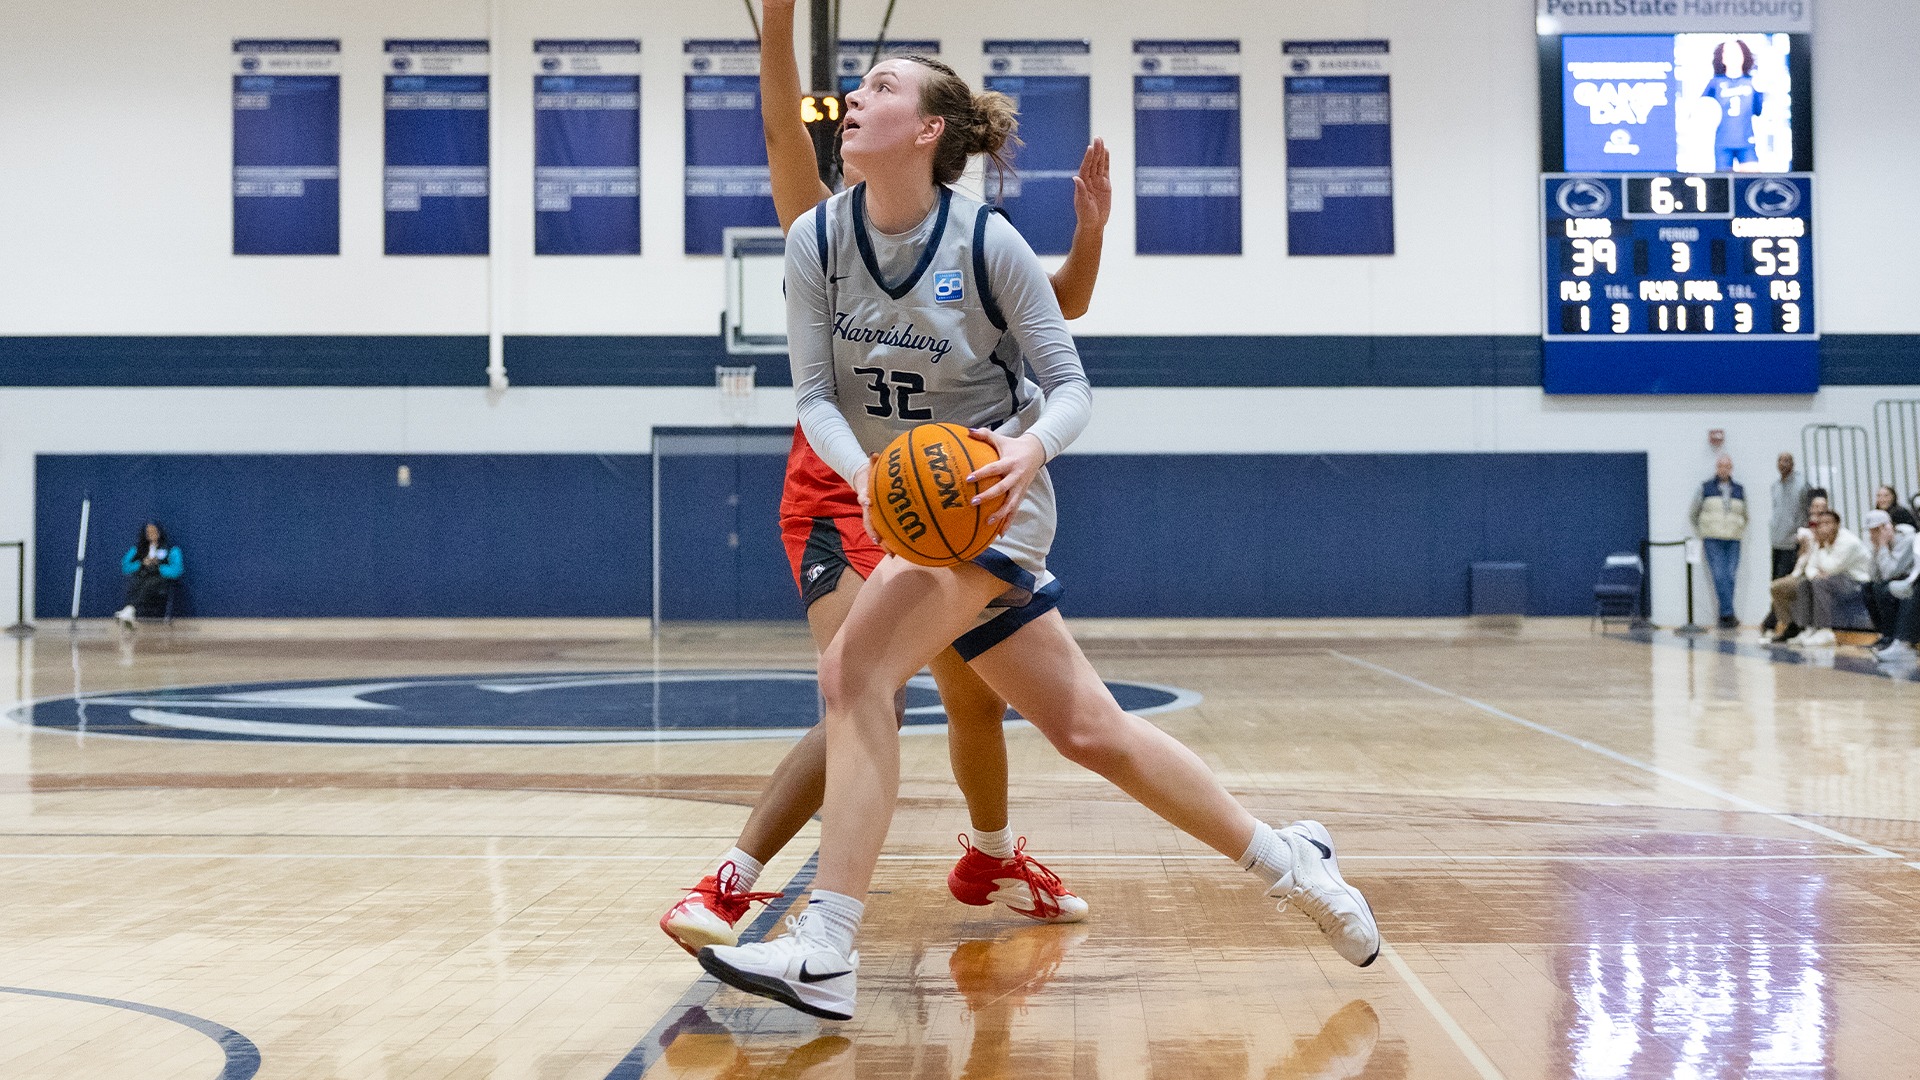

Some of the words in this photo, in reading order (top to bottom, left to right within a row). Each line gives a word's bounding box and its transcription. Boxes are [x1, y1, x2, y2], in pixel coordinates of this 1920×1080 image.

[800, 96, 839, 123] 6.7
[1573, 82, 1668, 106] GAME
[1651, 177, 1706, 214] 6.7
[1658, 227, 1700, 242] PERIOD
[1572, 239, 1617, 276] 39
[1671, 242, 1690, 273] 3
[1752, 238, 1799, 276] 53
[1580, 304, 1590, 331] 1
[1611, 303, 1630, 333] 3
[1734, 302, 1752, 333] 3
[1781, 302, 1800, 333] 3
[832, 311, 952, 364] Harrisburg
[853, 366, 934, 421] 32
[923, 441, 964, 510] NCAA
[887, 447, 928, 543] Wilson
